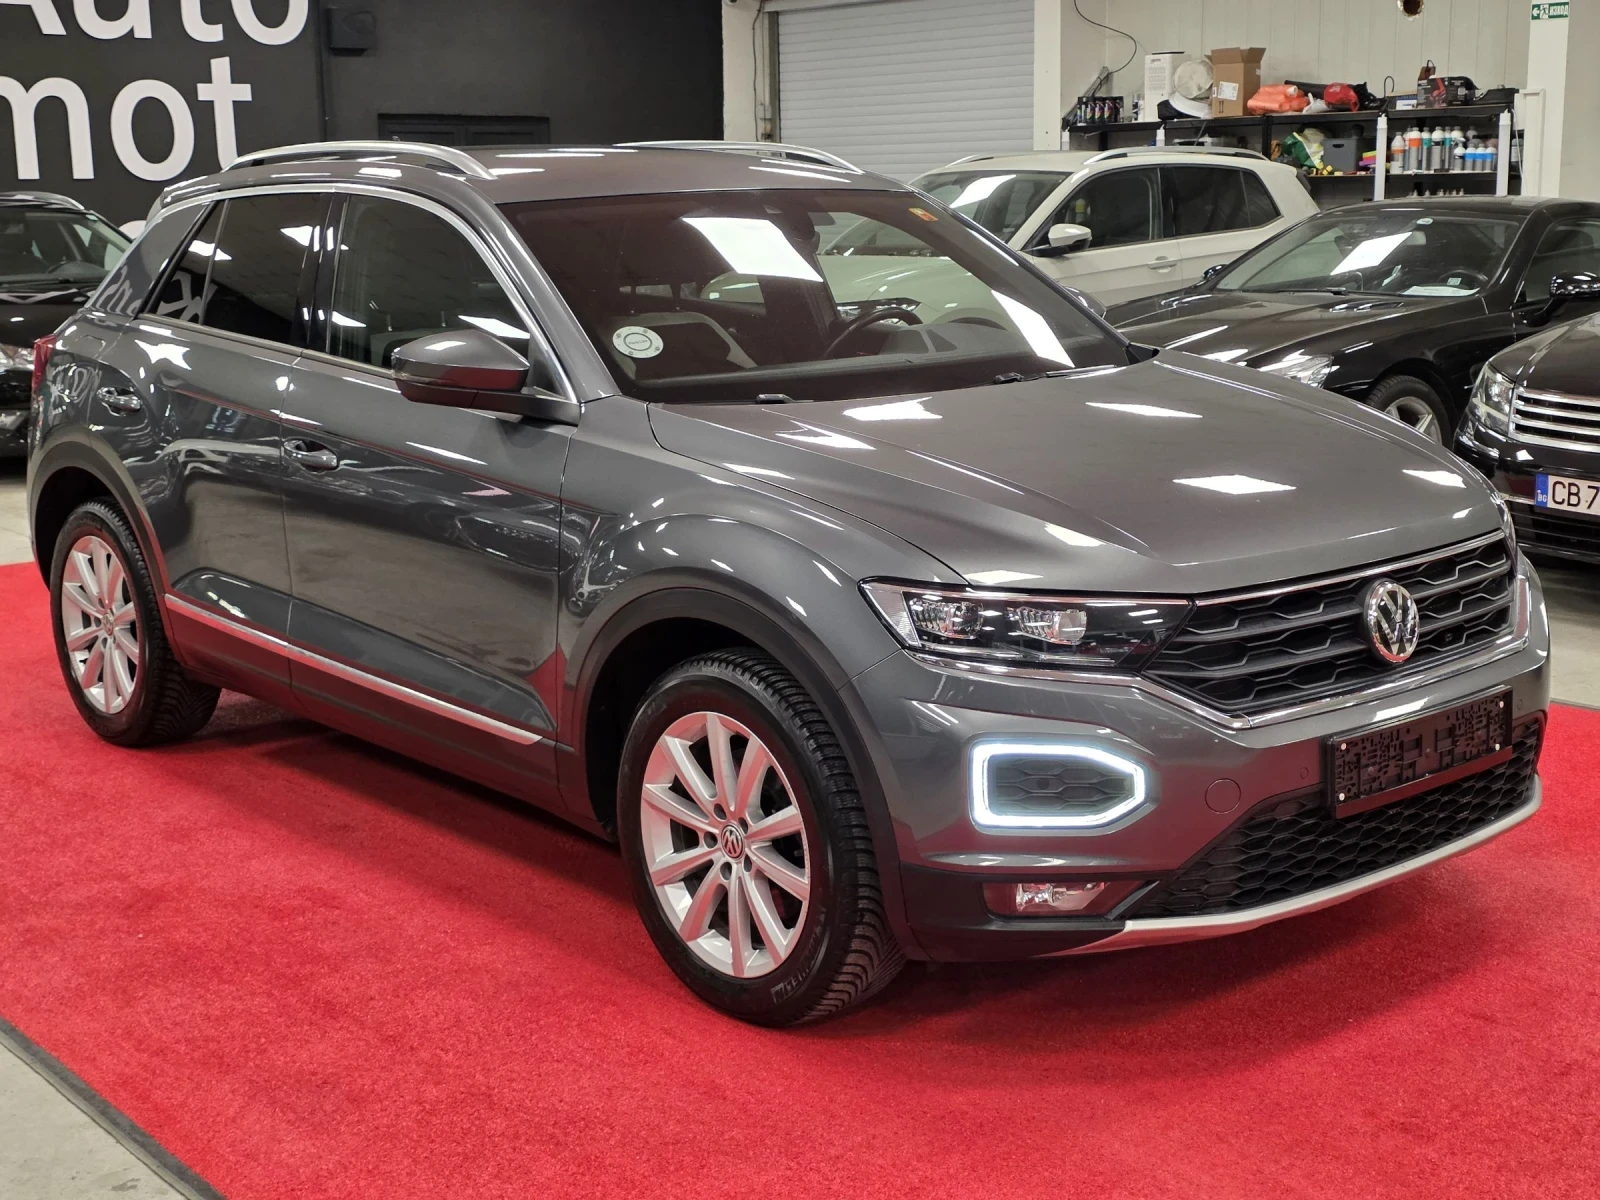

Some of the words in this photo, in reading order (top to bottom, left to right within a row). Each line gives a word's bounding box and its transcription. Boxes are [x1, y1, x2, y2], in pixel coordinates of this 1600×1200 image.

[1537, 494, 1548, 503] BG
[1552, 480, 1581, 507] CB
[1371, 584, 1418, 660] VW
